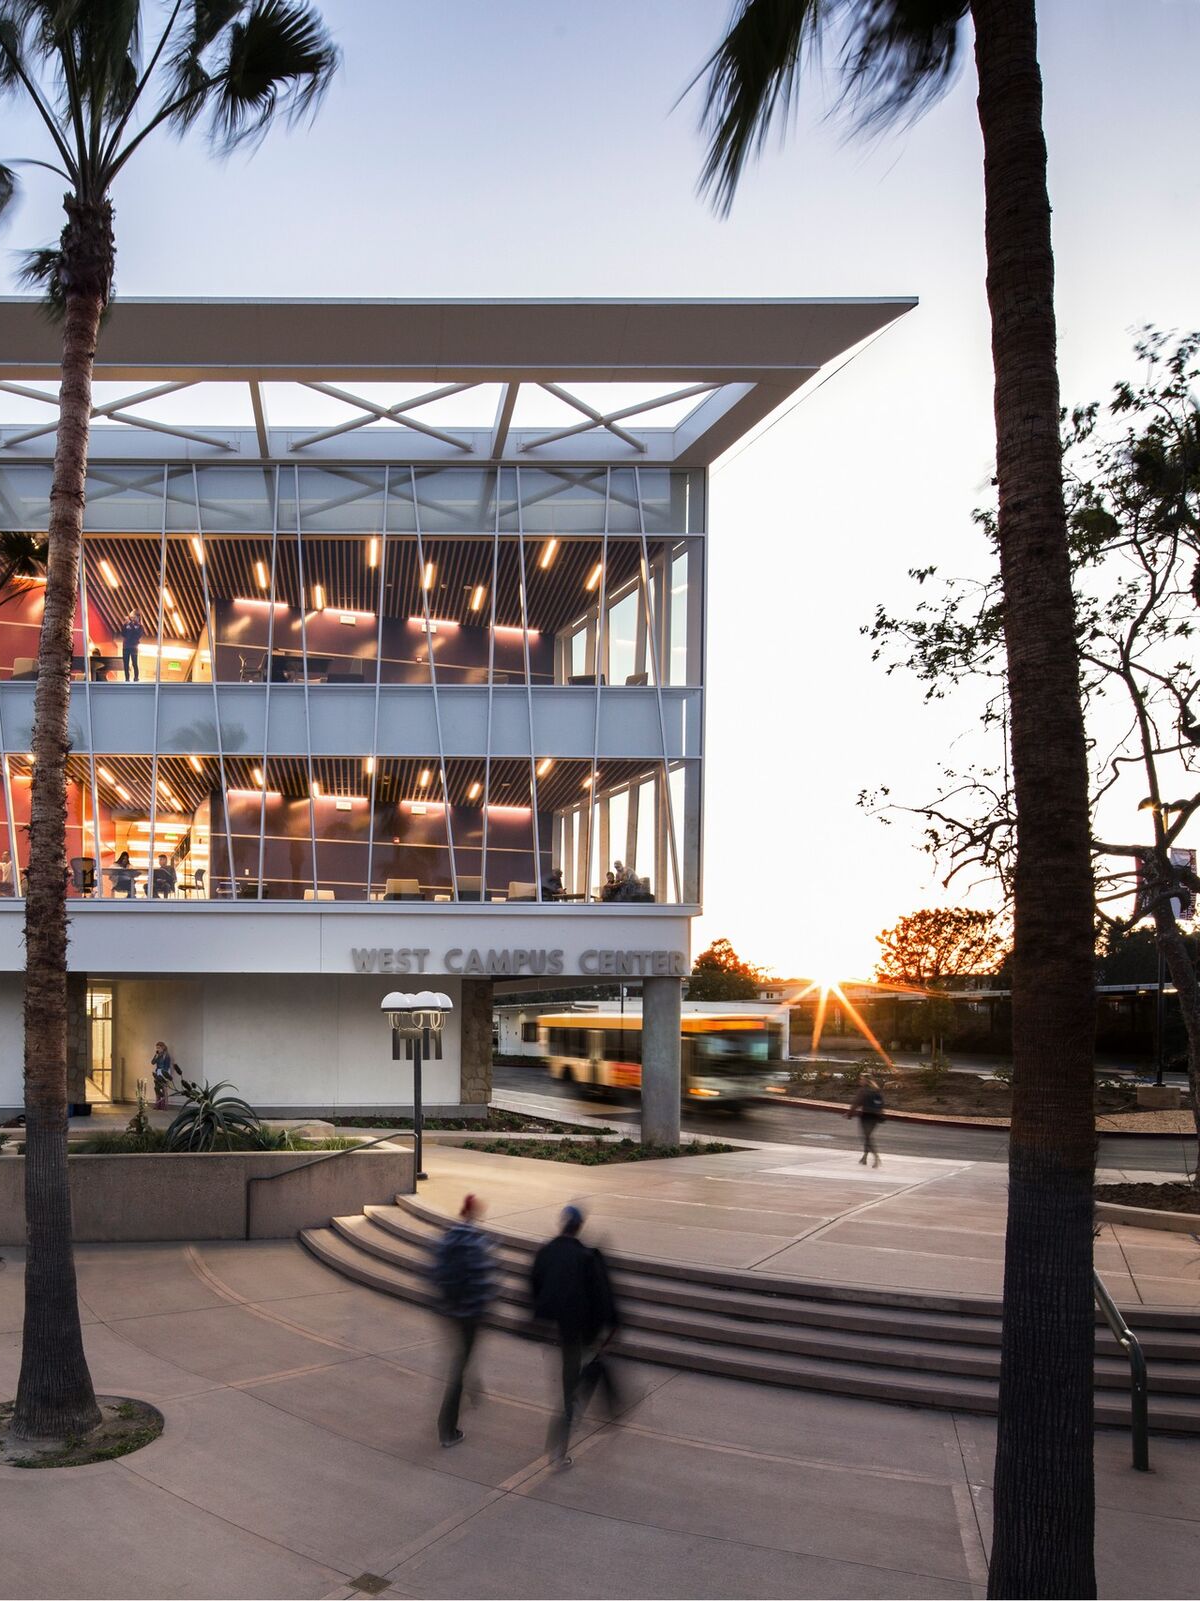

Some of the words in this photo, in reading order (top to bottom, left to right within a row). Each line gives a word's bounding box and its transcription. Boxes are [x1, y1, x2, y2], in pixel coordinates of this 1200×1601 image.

[351, 948, 430, 972] WEST
[444, 948, 564, 974] CAMPUS
[578, 949, 685, 975] CENTER
